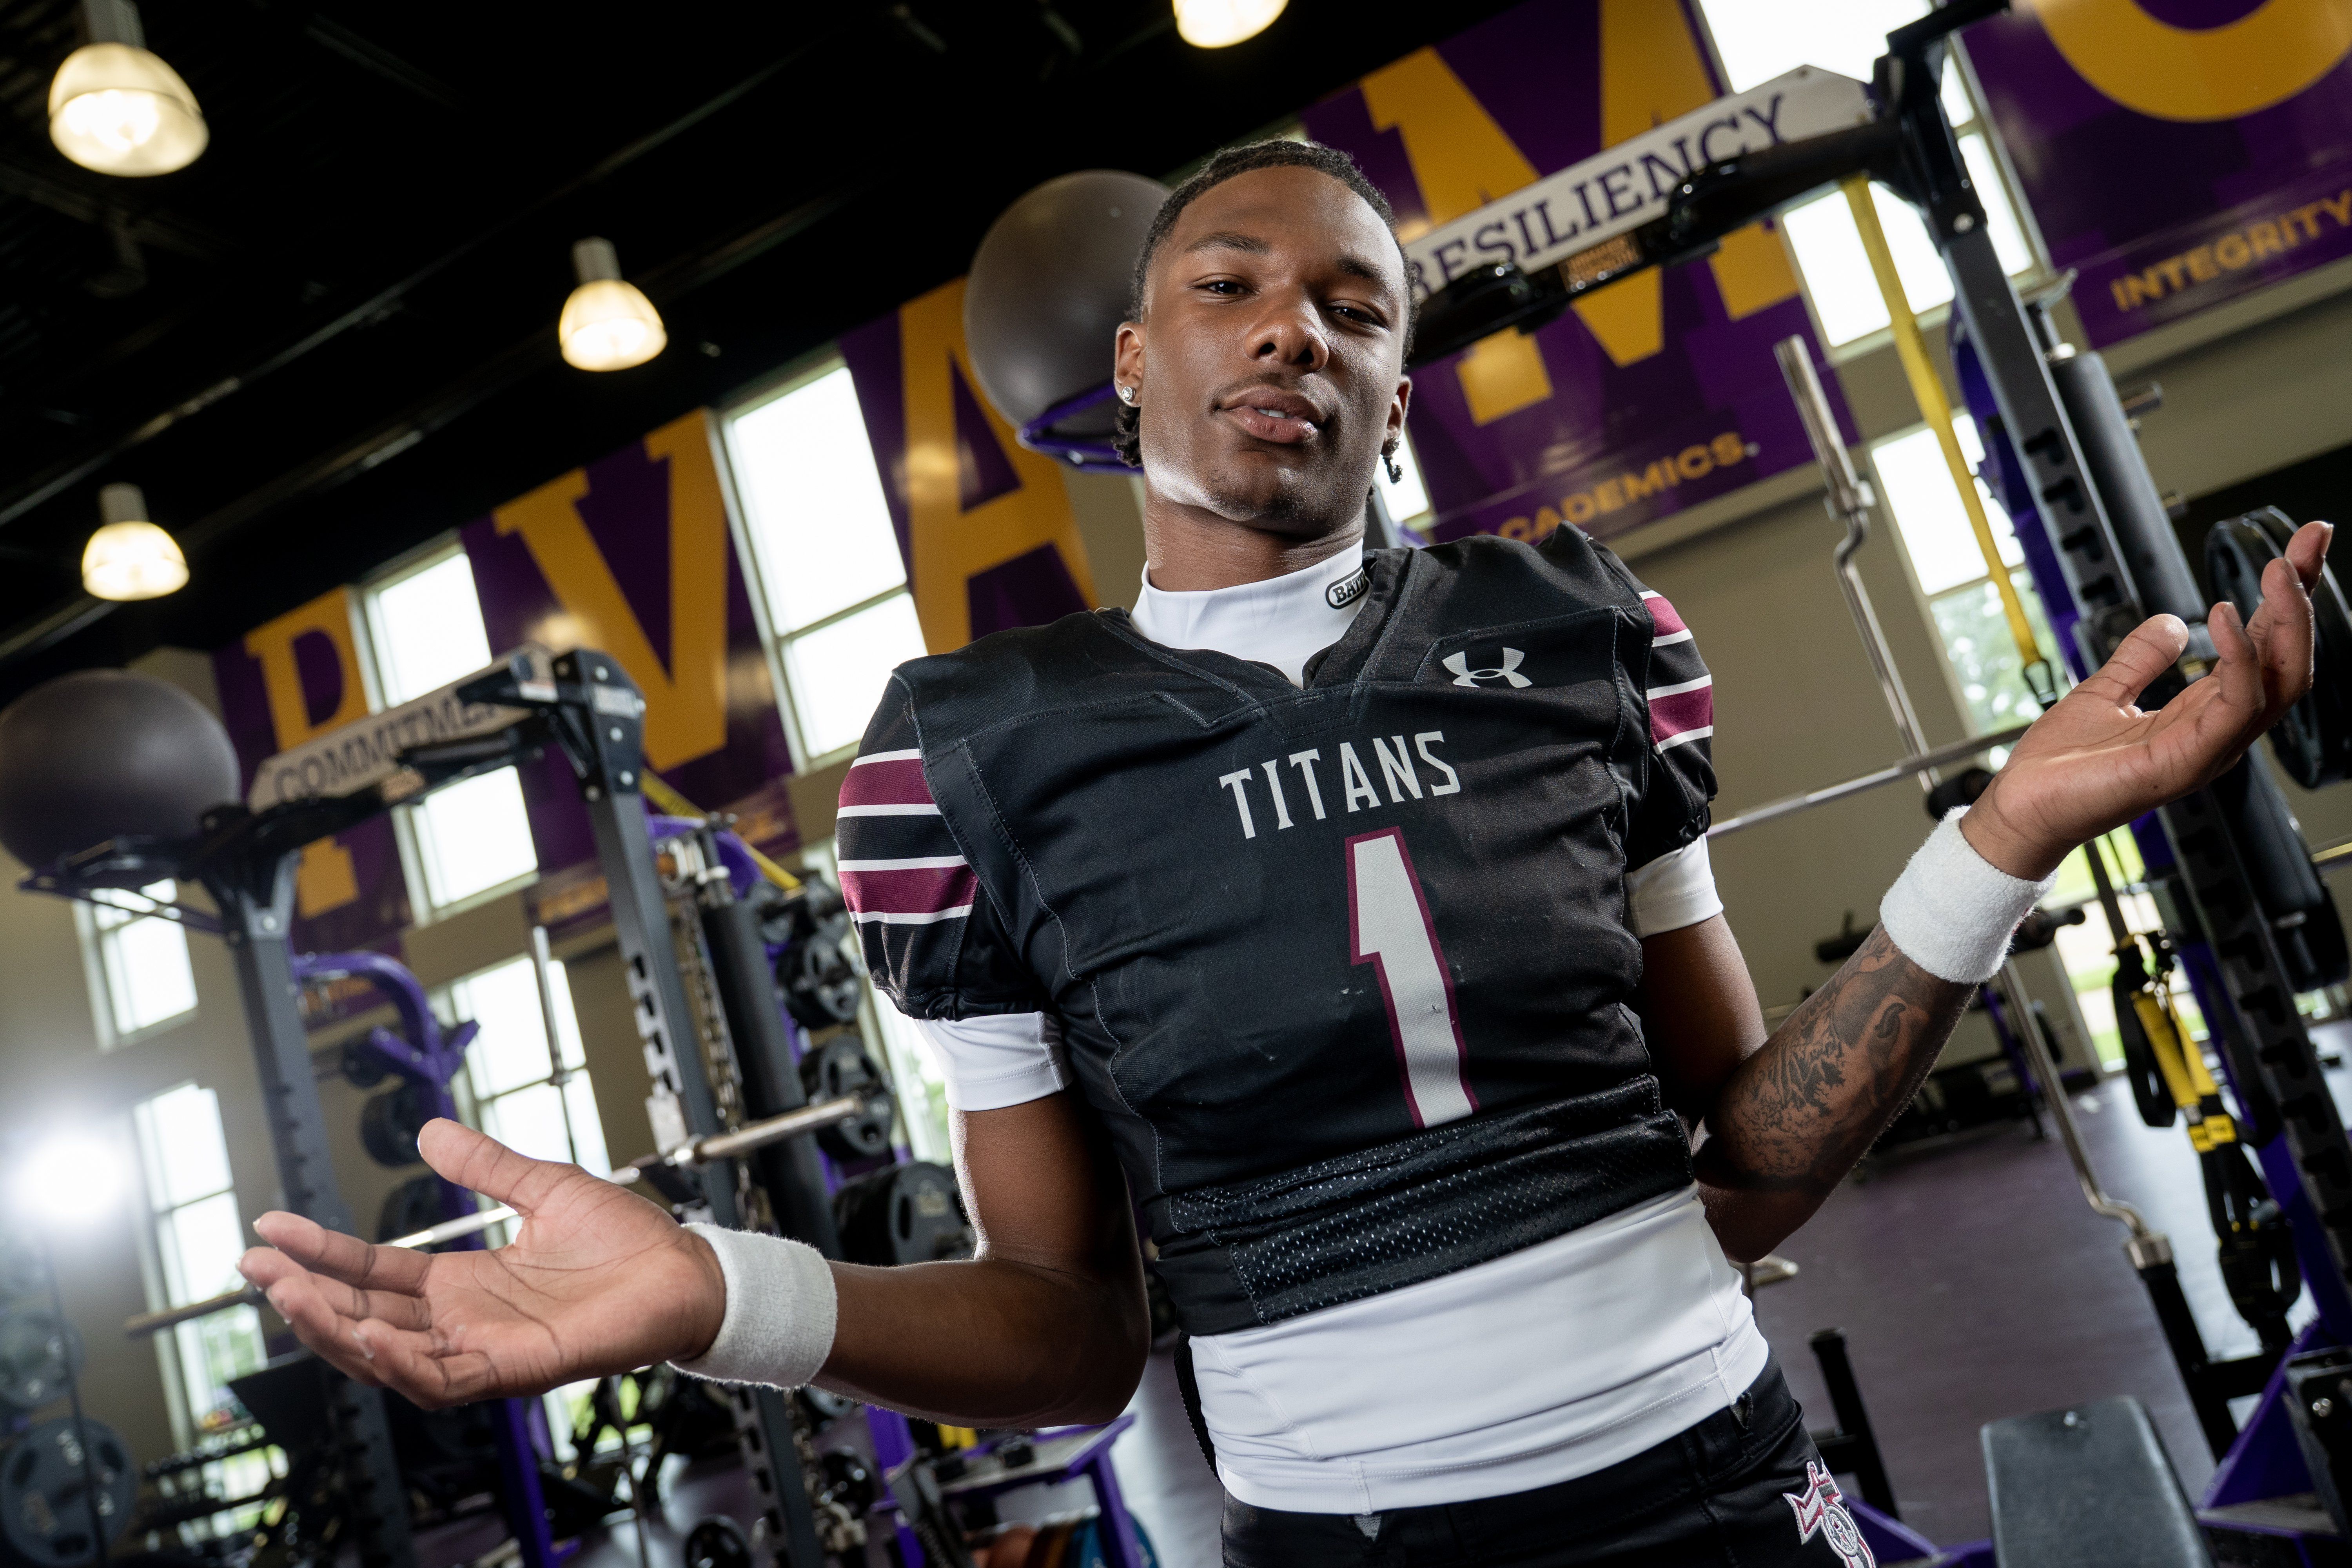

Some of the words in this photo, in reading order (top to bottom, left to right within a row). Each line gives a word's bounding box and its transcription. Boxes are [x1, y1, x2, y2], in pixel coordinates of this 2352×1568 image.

[2110, 189, 2352, 312] INTEGRITY
[1476, 432, 1761, 545] CADEMICS.
[1219, 731, 1461, 839] TITANS
[1345, 826, 1480, 1130] 1
